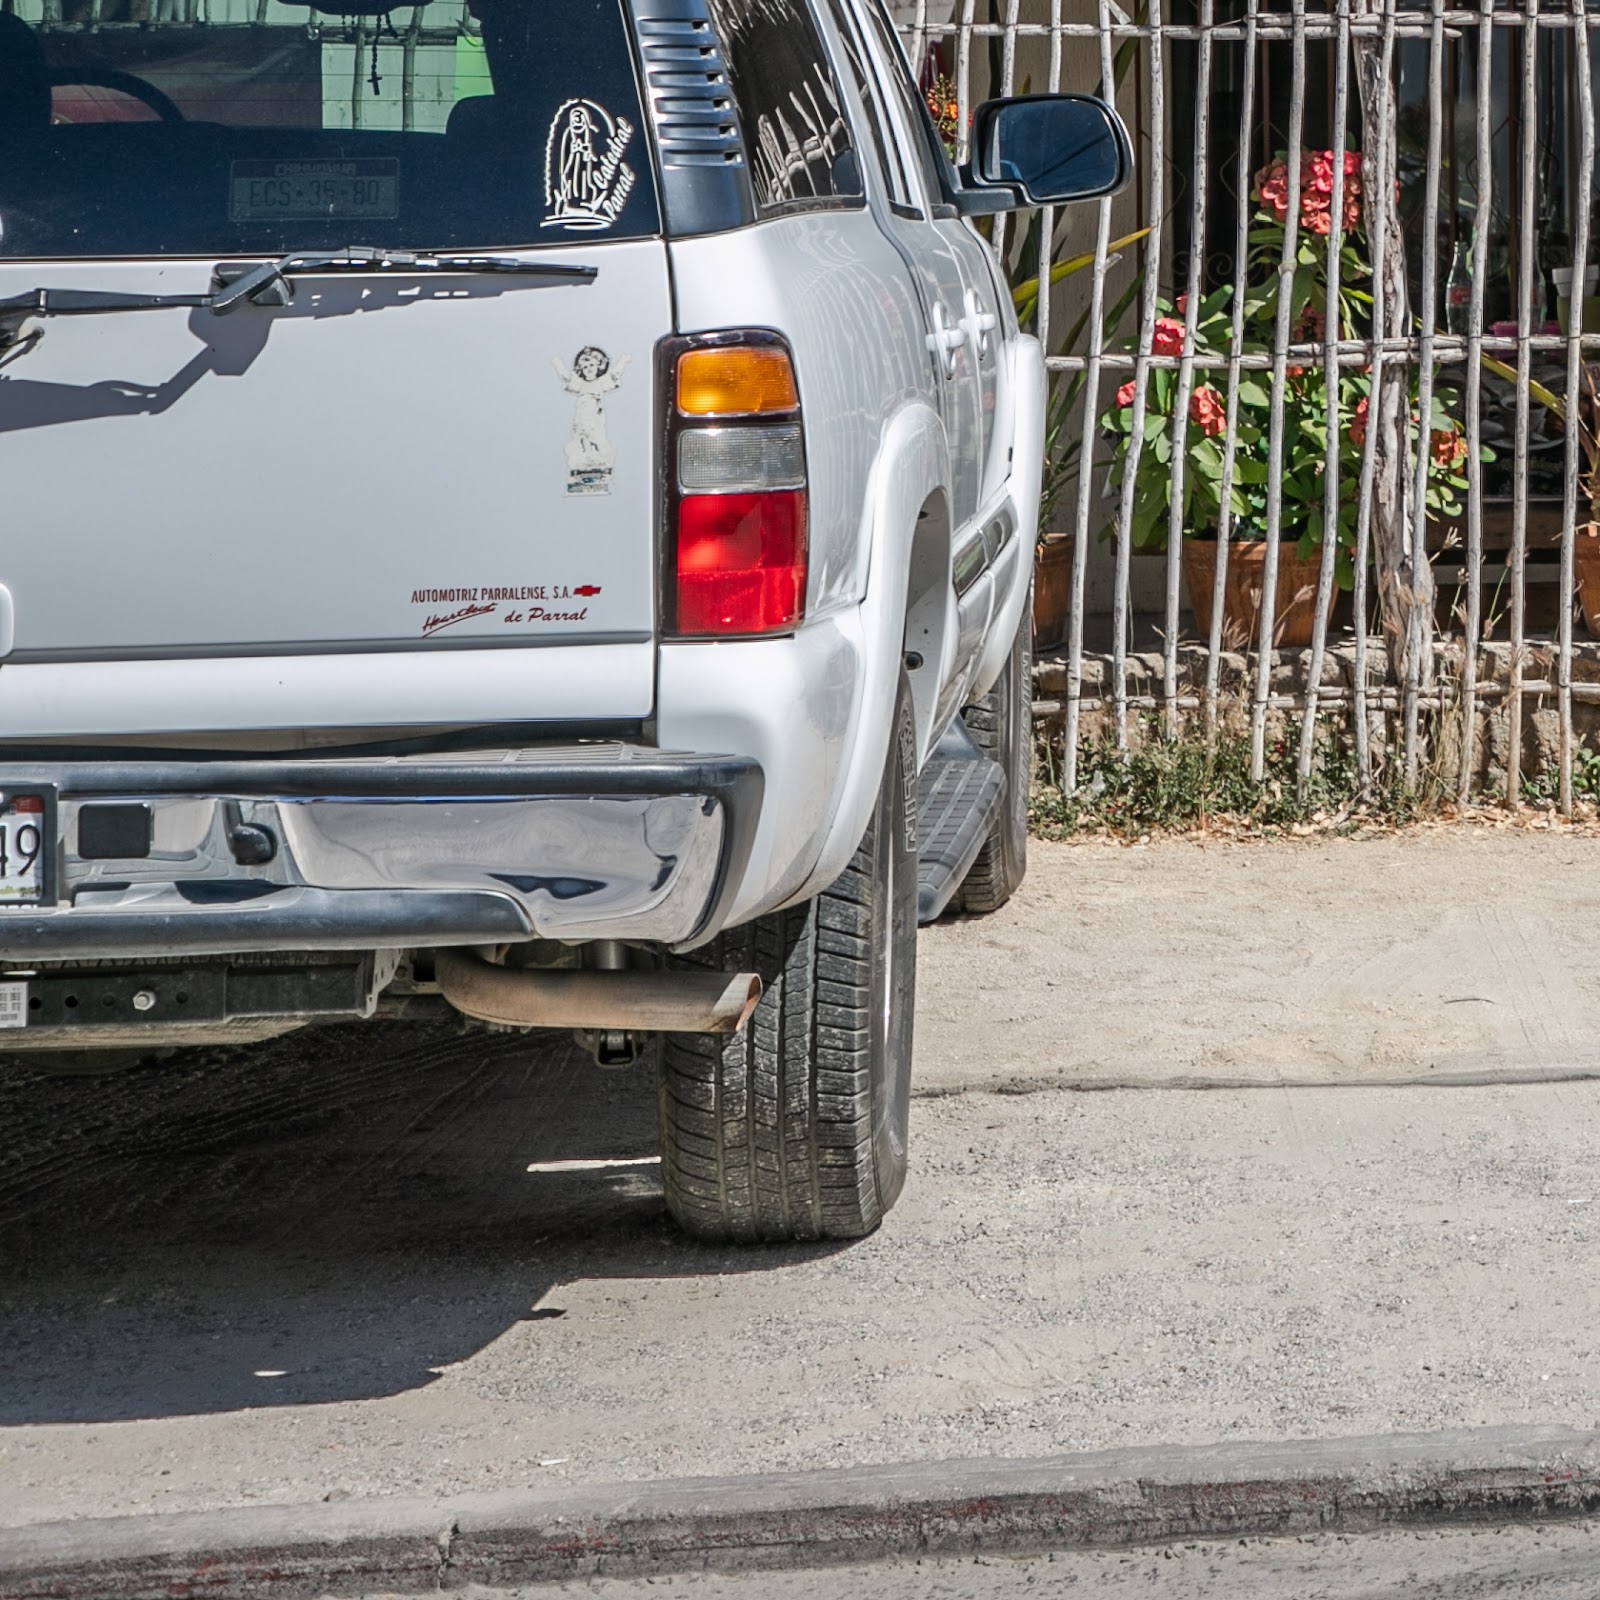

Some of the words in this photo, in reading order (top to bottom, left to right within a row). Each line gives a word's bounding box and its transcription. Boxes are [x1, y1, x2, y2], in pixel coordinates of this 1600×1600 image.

[411, 587, 478, 603] AUTOMOTRIZ
[481, 586, 549, 601] PARRALENSE,
[552, 585, 573, 599] S.A.
[504, 610, 523, 623] de
[527, 607, 588, 622] Parral
